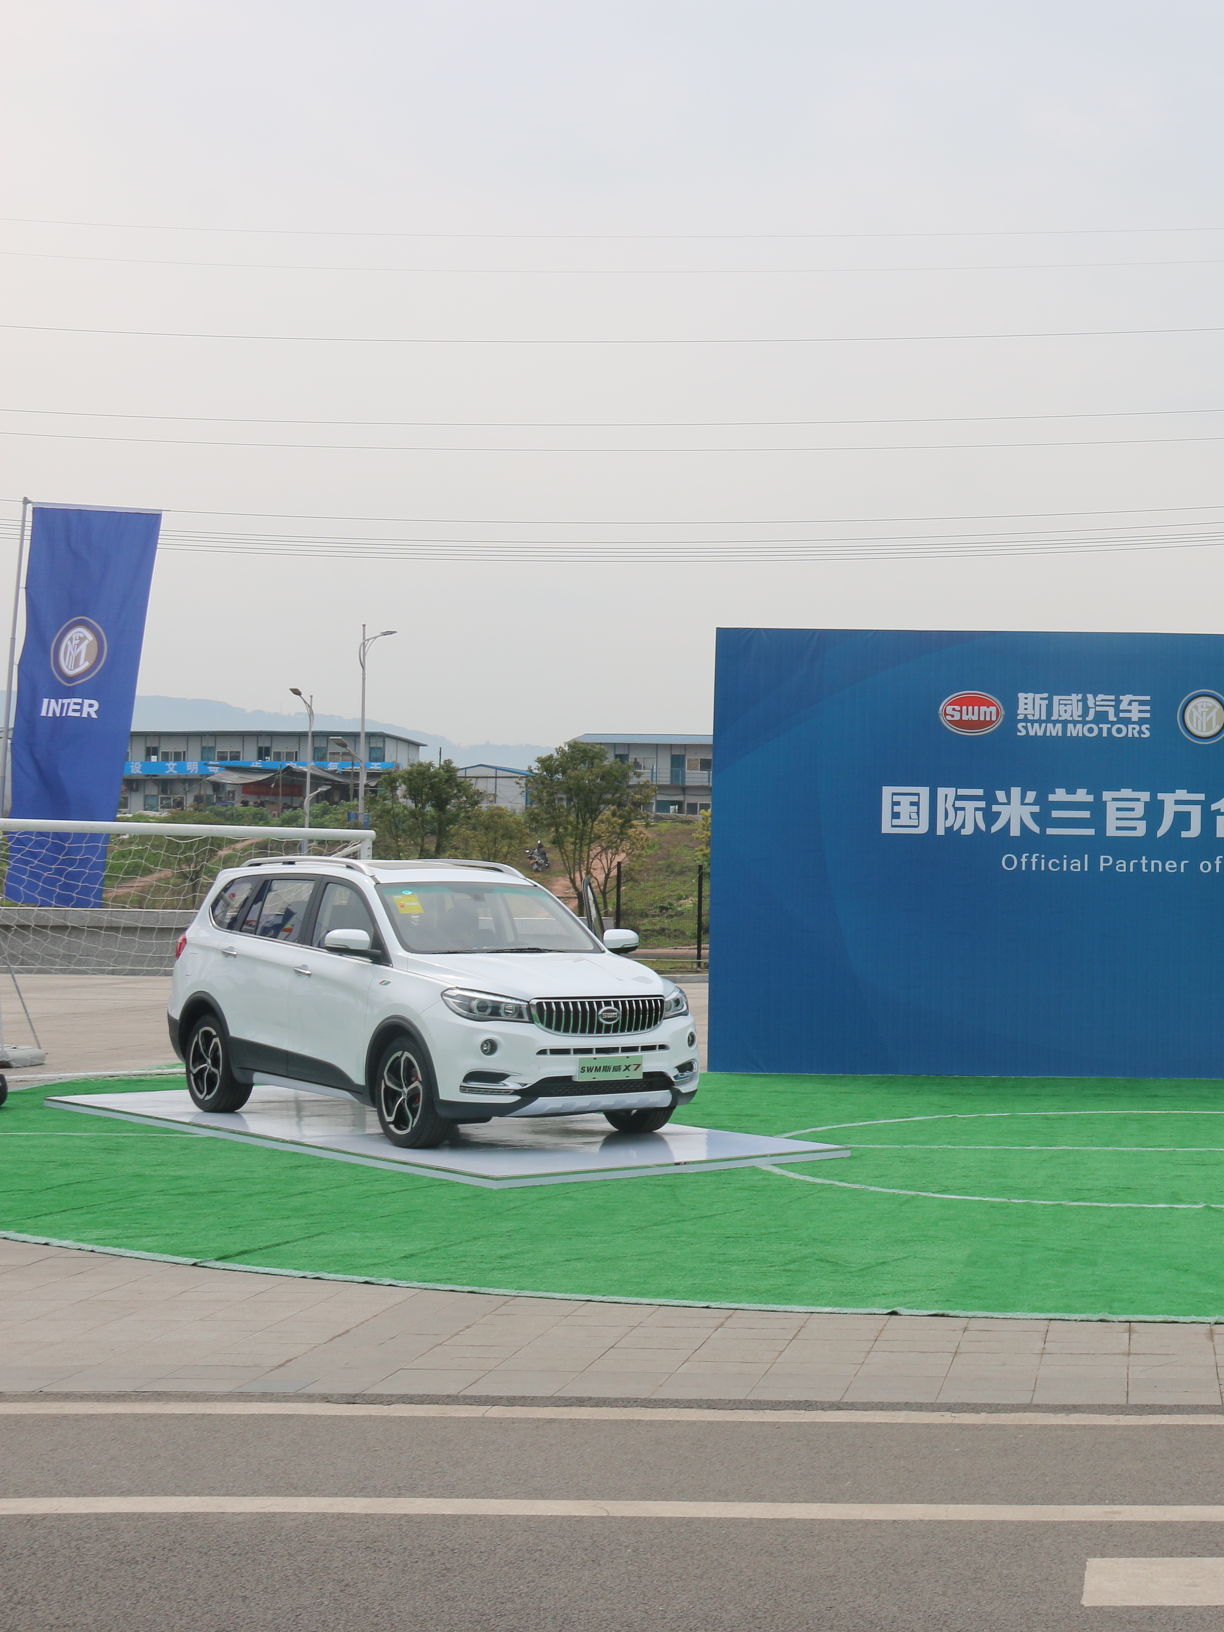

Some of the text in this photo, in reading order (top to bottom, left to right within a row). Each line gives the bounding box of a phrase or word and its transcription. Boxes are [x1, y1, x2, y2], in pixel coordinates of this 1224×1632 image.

[40, 697, 99, 719] INTER
[1016, 692, 1151, 722] 斯威汽车
[1016, 723, 1151, 738] SWM MOTORS
[1001, 853, 1089, 872] Official
[1099, 855, 1189, 873] Partner
[1199, 855, 1223, 874] of
